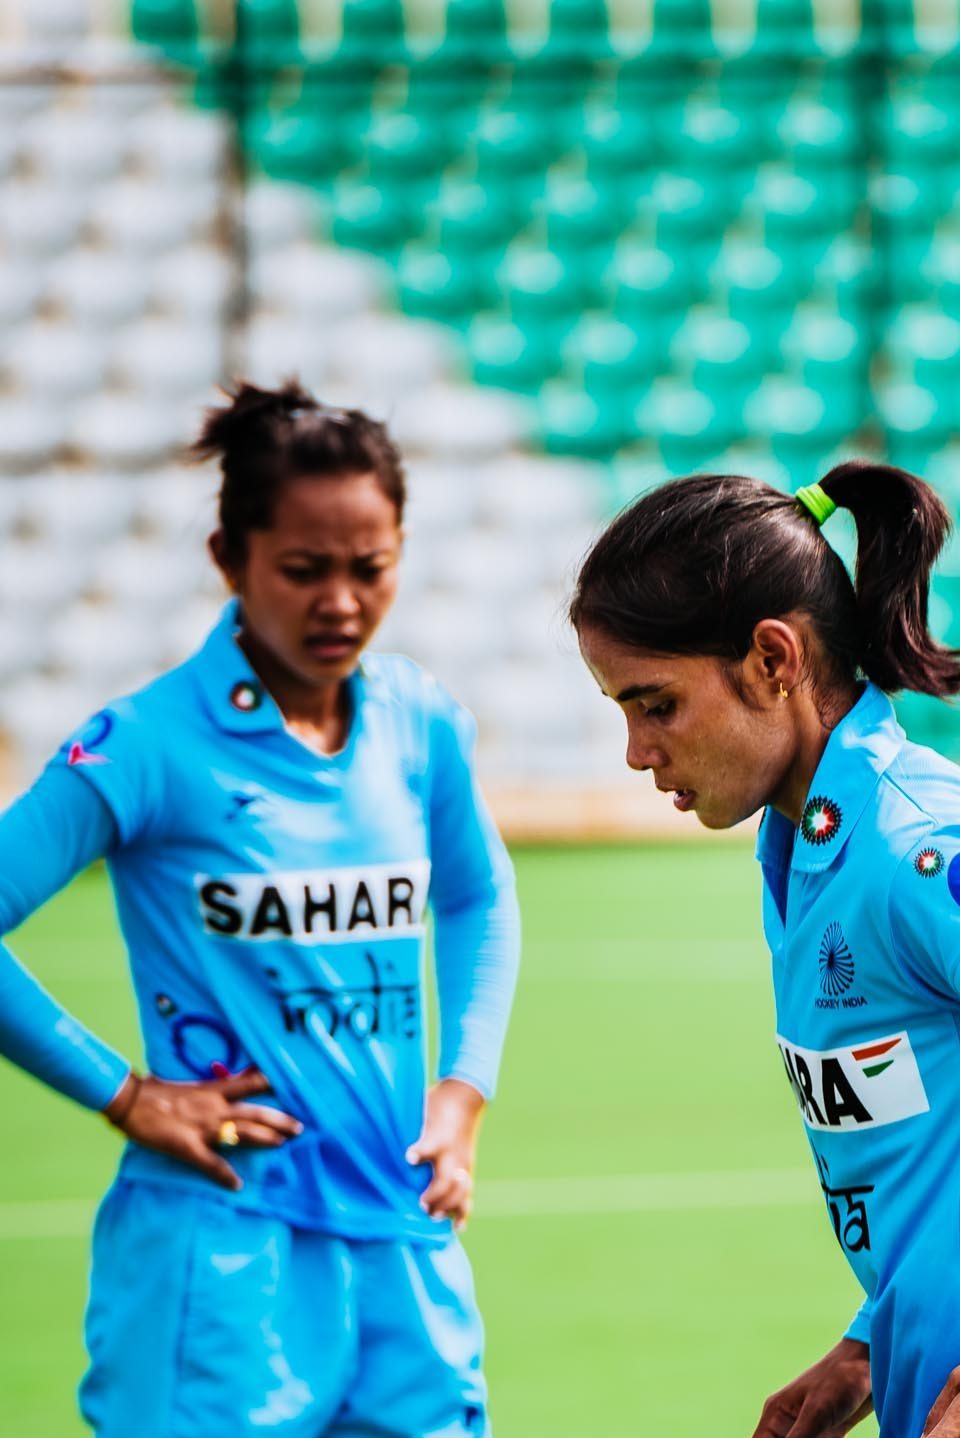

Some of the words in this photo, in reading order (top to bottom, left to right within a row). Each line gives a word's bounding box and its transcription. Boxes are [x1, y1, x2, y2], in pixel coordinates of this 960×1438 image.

[814, 997, 840, 1010] HOCKEY
[841, 996, 868, 1009] INDIA
[778, 1042, 874, 1127] RA
